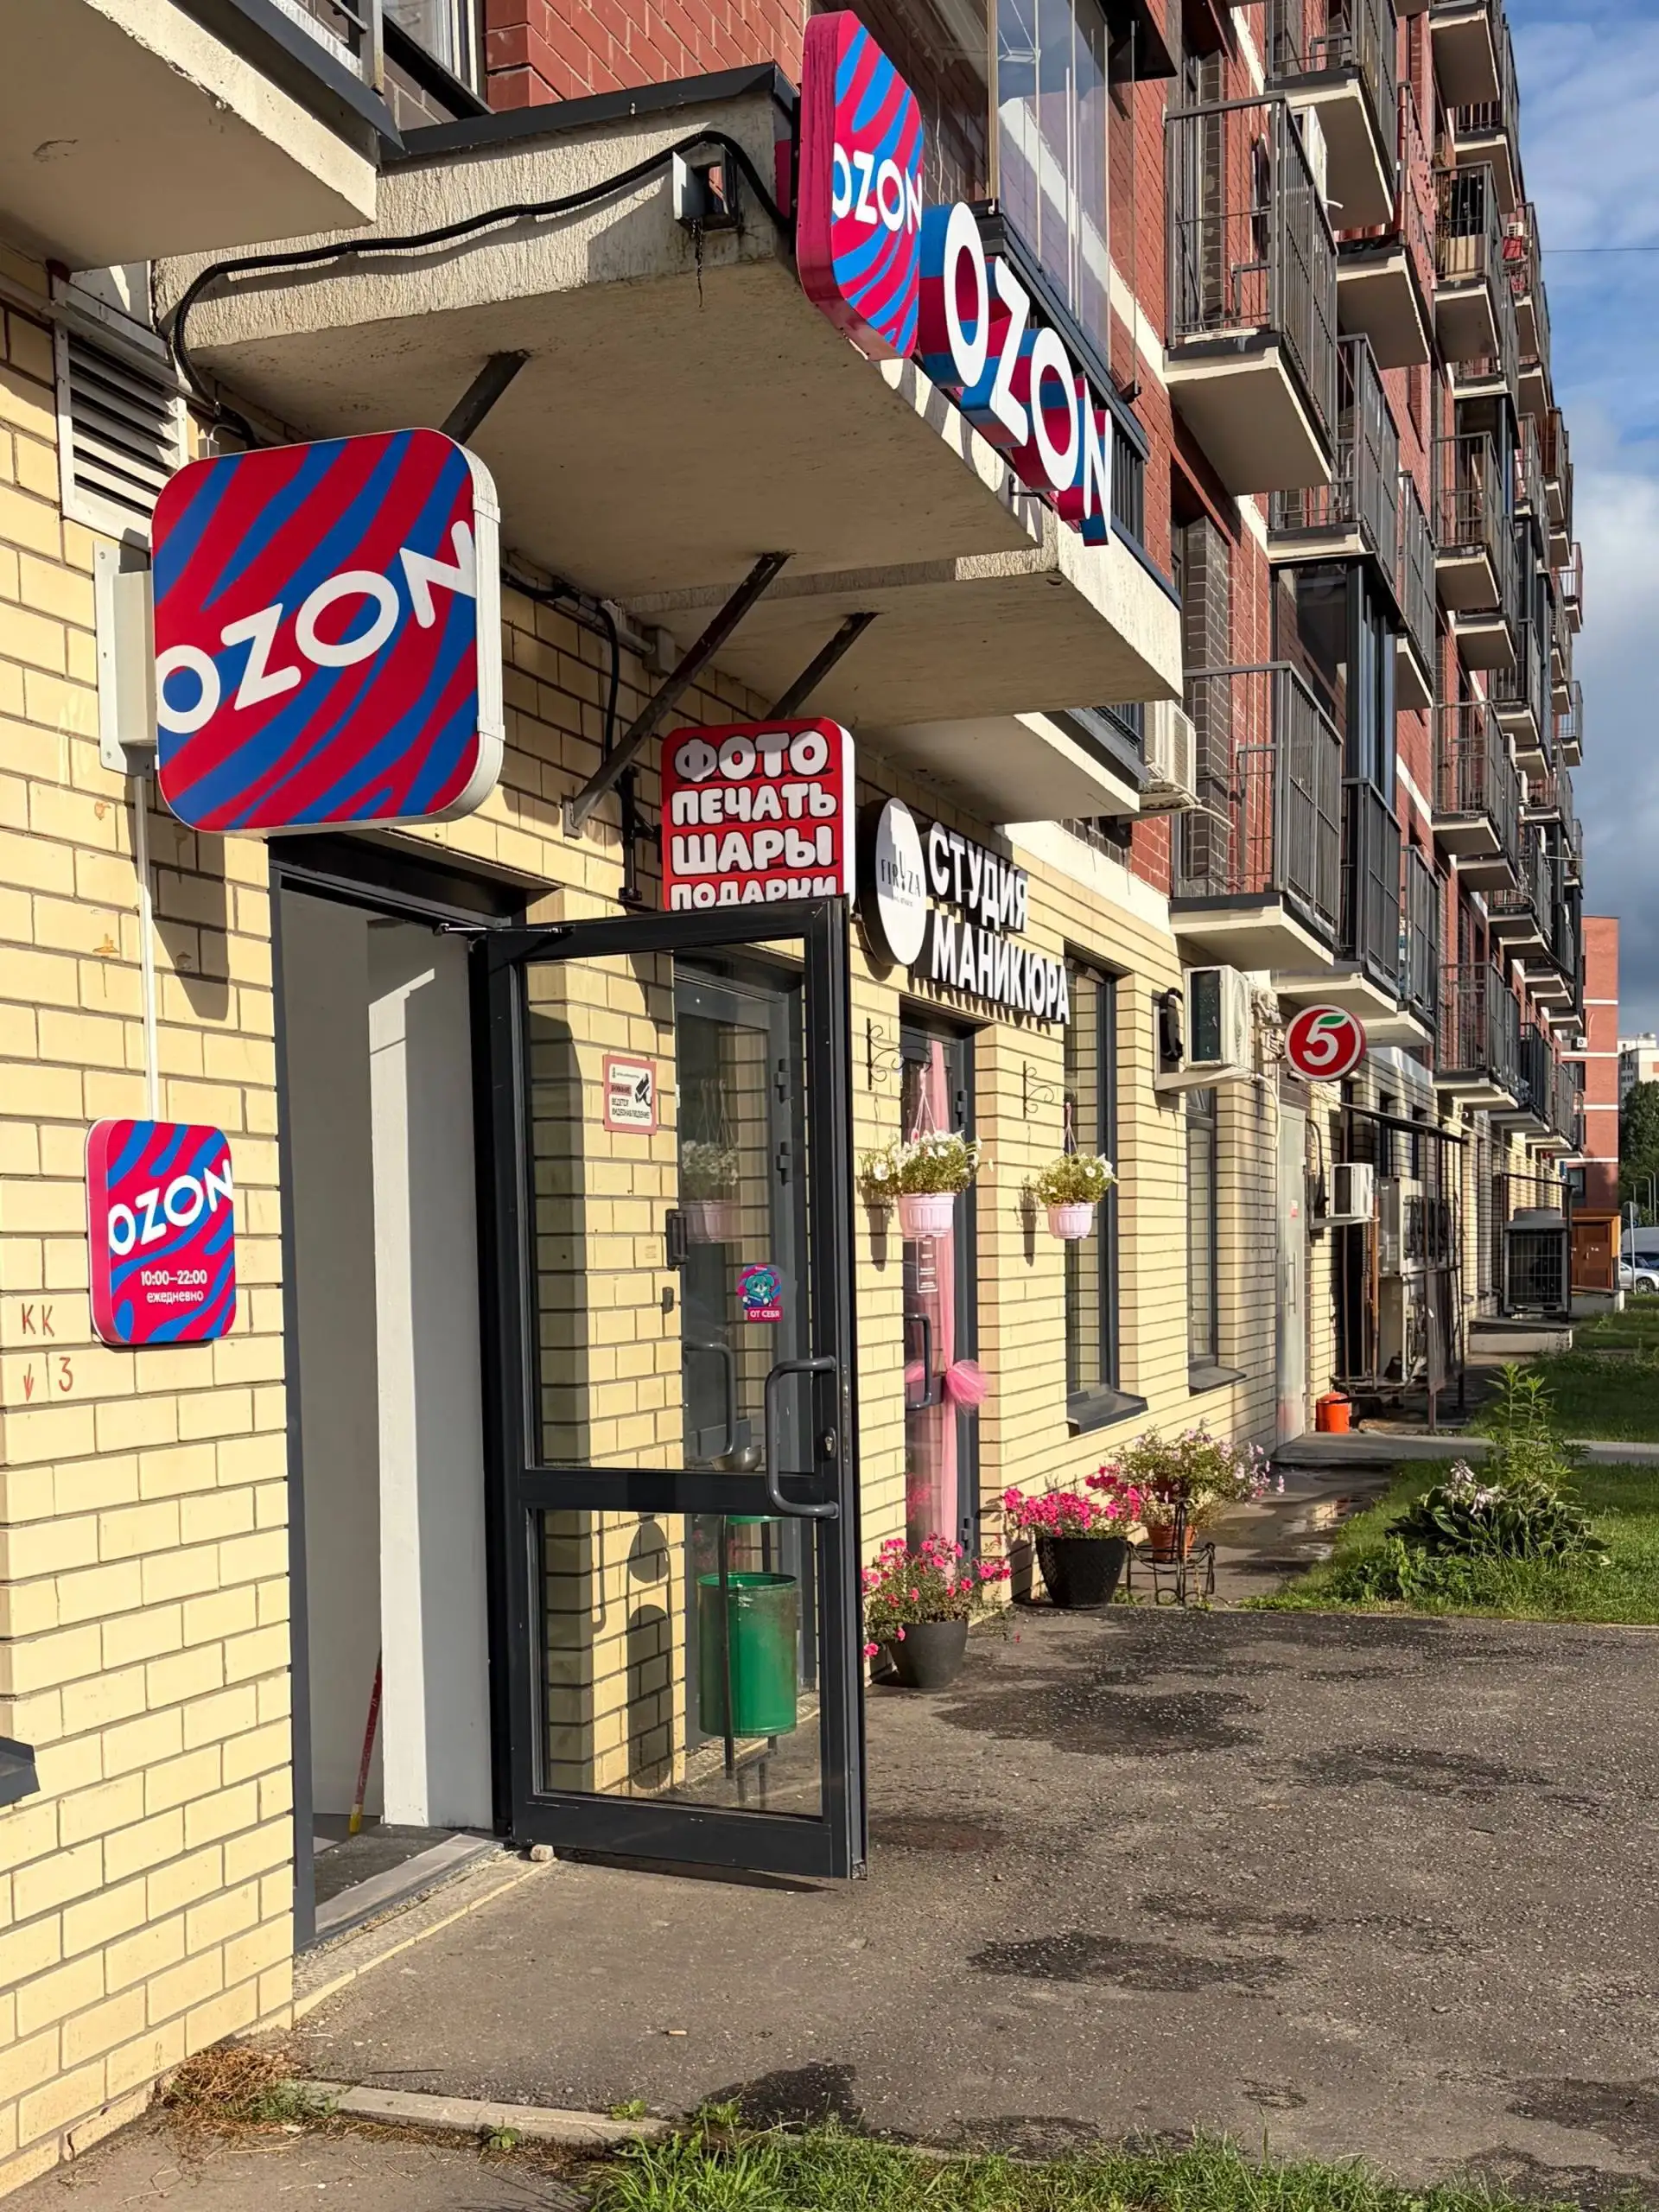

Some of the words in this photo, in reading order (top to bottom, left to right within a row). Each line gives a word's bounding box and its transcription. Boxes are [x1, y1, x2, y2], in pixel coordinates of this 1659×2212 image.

[831, 143, 923, 234] OZON
[944, 201, 1112, 537] OZON
[156, 520, 477, 734] OZON
[674, 730, 829, 783] ФОТО
[671, 782, 837, 826] ПЕЧАТЬ
[671, 825, 834, 875] ШАРЫ
[929, 821, 1028, 933] СТУДИЯ
[671, 876, 836, 912] ПОДАРКИ
[931, 908, 1071, 1025] МАНИКЮРА
[1302, 1012, 1349, 1066] 5
[108, 1159, 234, 1255] OZON
[146, 1290, 204, 1305] ежедневно
